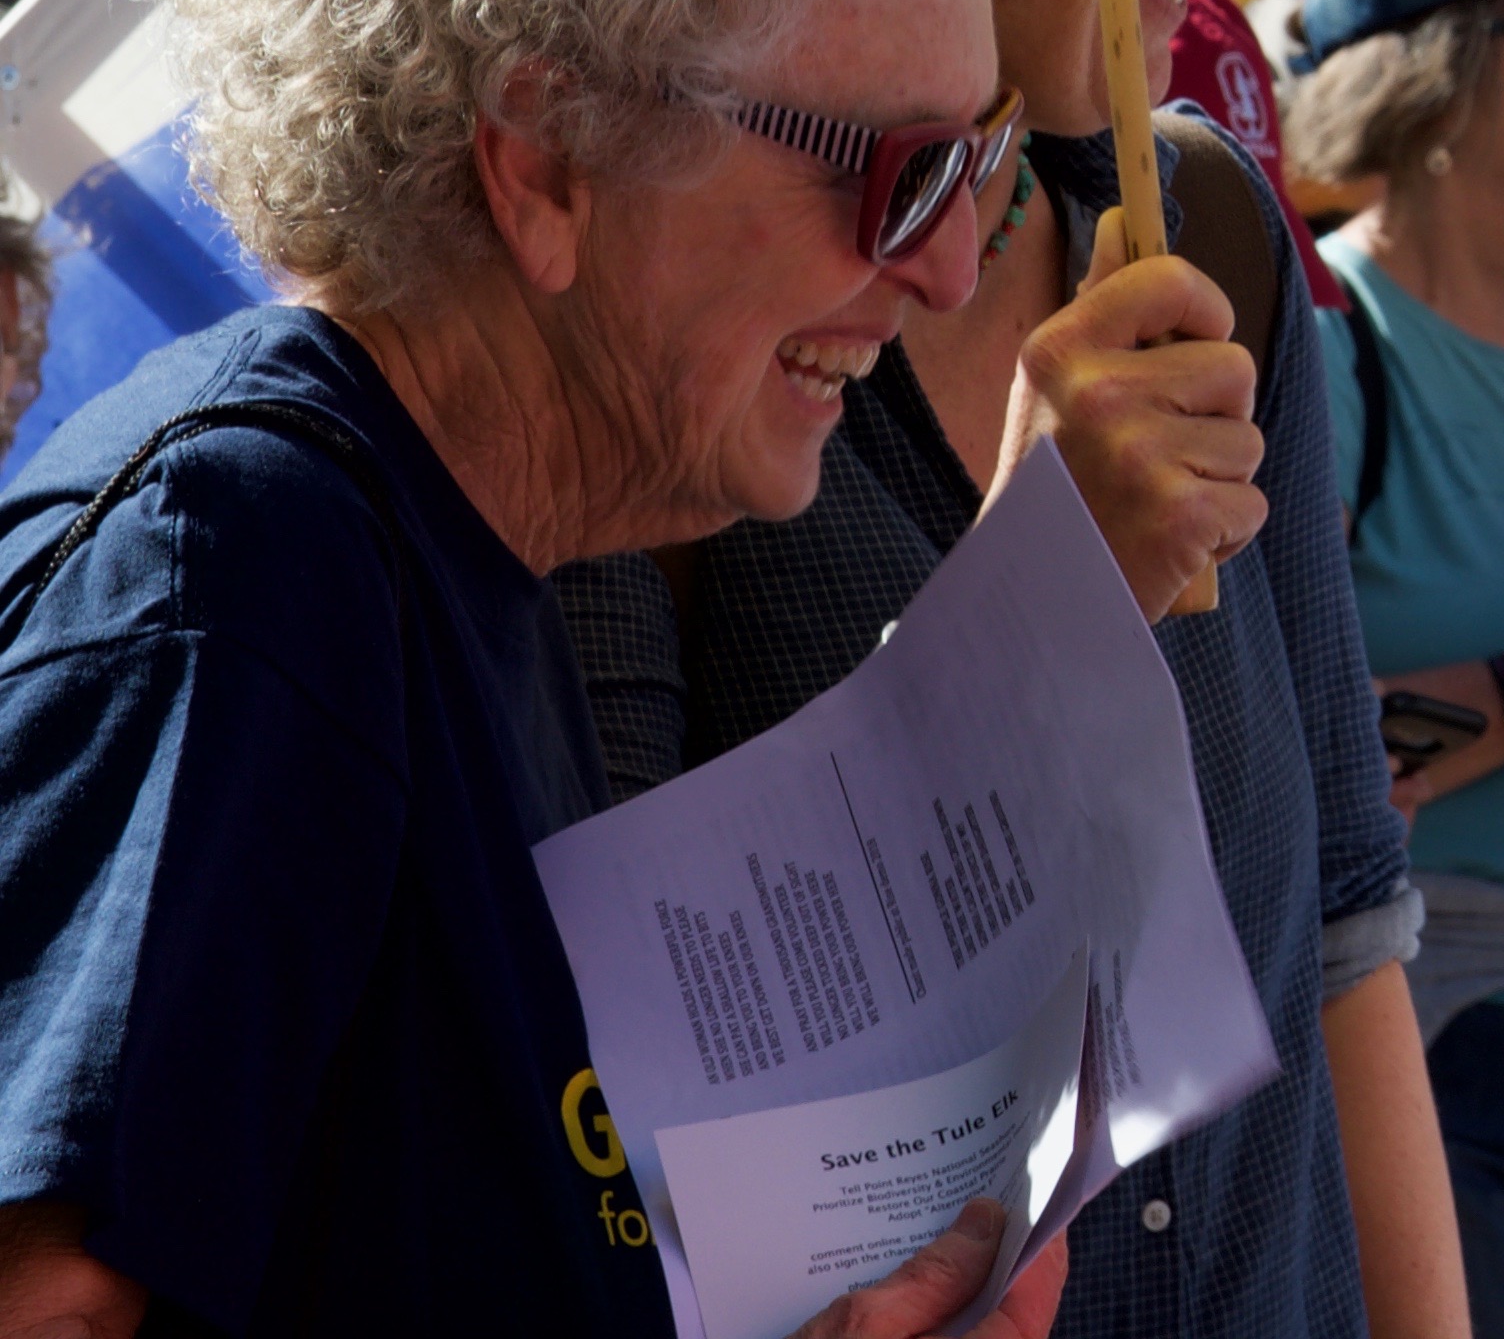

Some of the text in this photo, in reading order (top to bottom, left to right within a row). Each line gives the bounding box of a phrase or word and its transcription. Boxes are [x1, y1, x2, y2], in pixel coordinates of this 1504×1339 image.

[821, 1150, 878, 1171] Save
[886, 1139, 926, 1158] the
[932, 1117, 985, 1145] Tule
[992, 1090, 1018, 1119] Elk
[839, 1184, 861, 1195] Tell
[864, 1179, 894, 1191] Point
[896, 1172, 929, 1185] Reyes
[932, 1152, 977, 1177] National
[813, 1197, 863, 1212] Prioritize
[867, 1183, 931, 1203] Biodiversity
[867, 1200, 910, 1214] Restore
[913, 1194, 934, 1205] Our
[937, 1176, 978, 1199] Coastal
[597, 1190, 658, 1248] fo
[888, 1209, 922, 1222] Adopt
[808, 1264, 831, 1275] also
[834, 1258, 858, 1270] sign
[861, 1254, 880, 1263] the
[810, 1244, 864, 1261] comment
